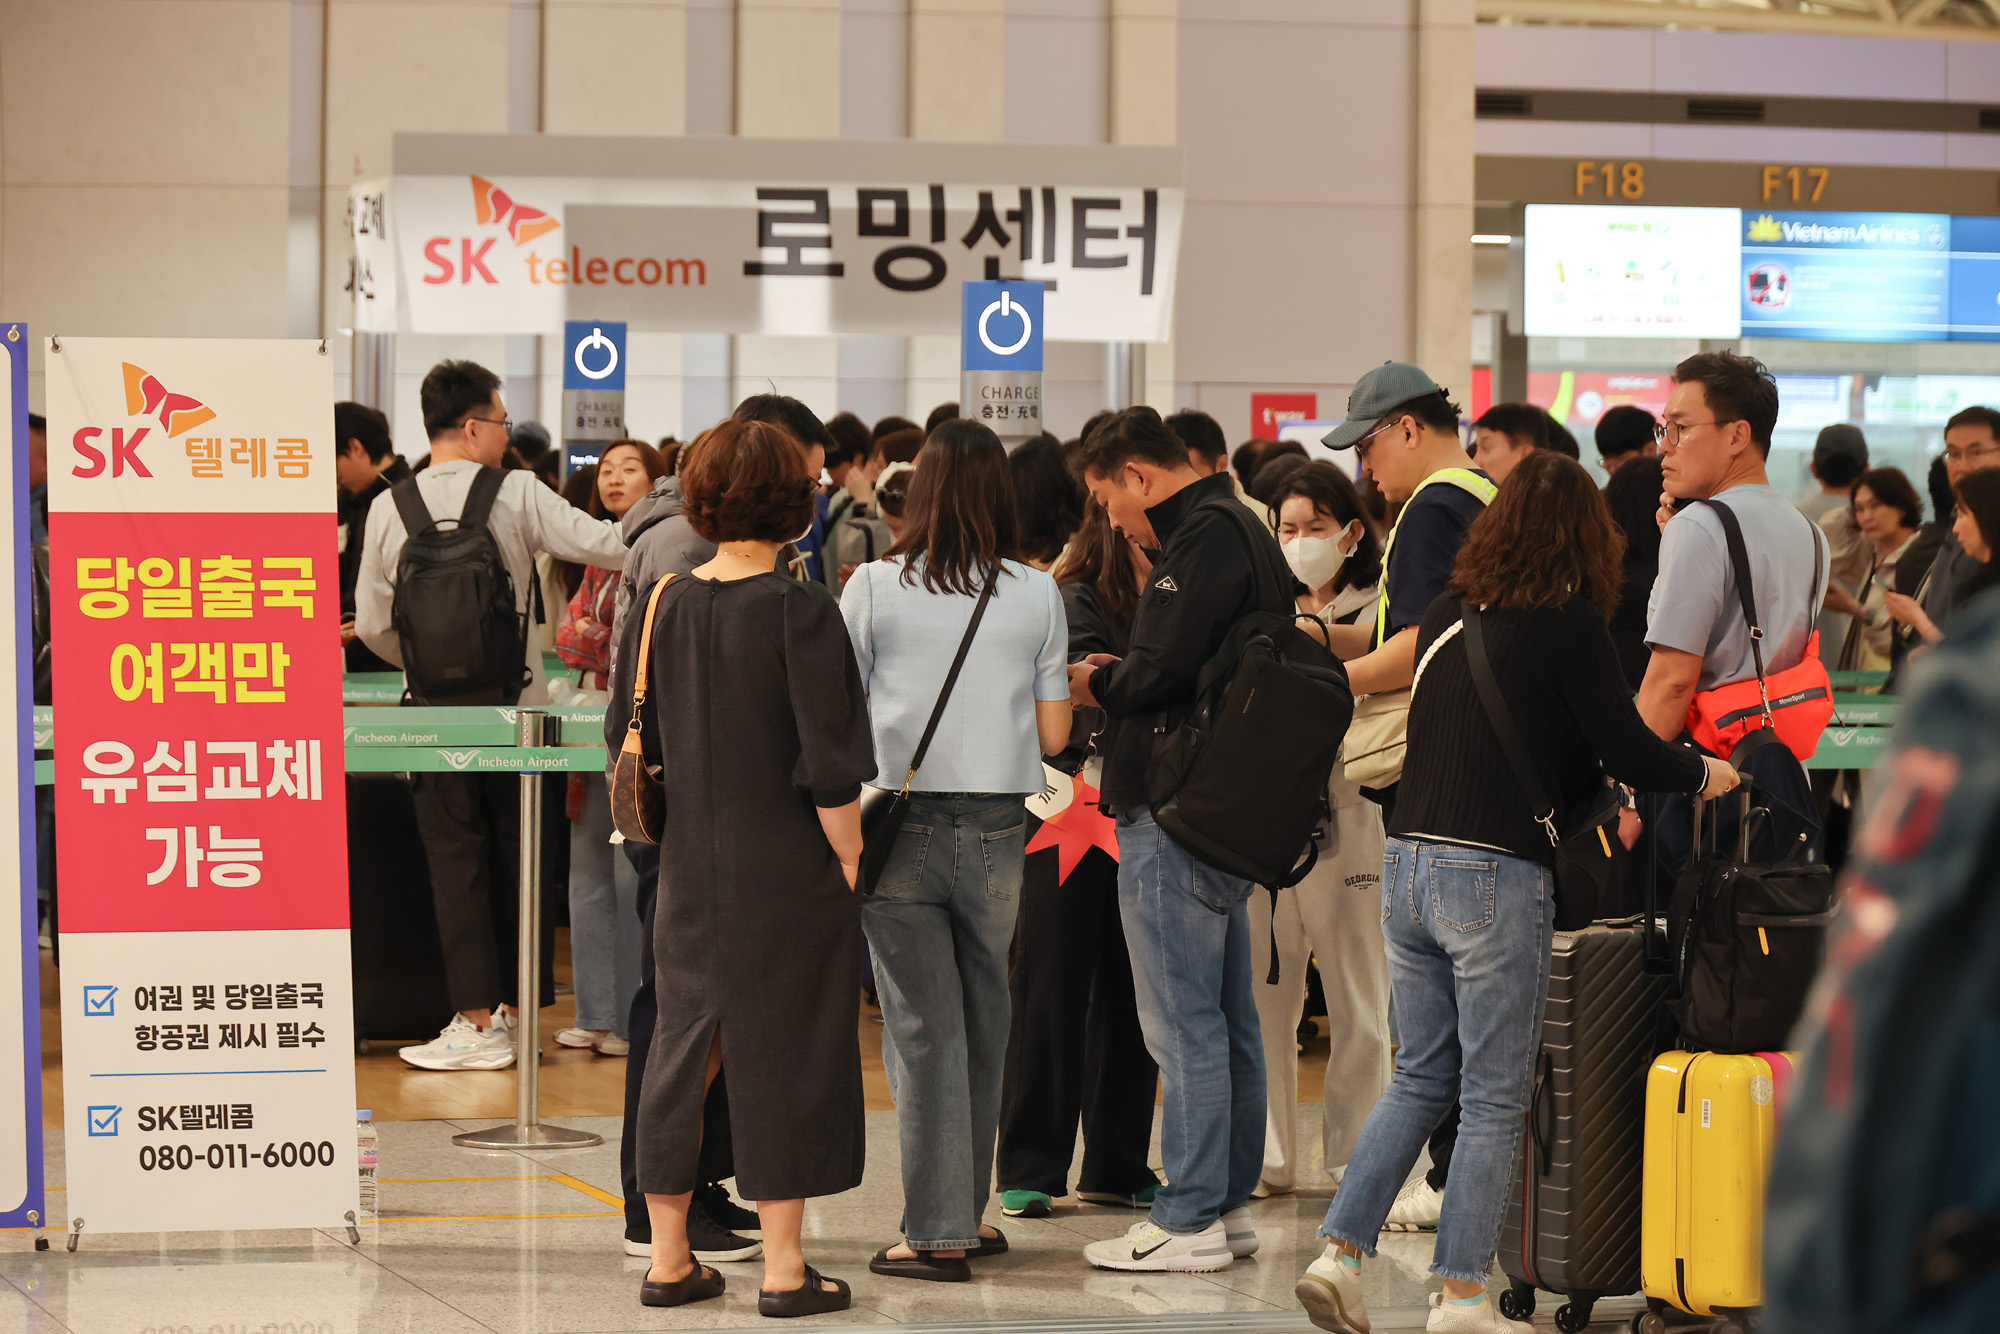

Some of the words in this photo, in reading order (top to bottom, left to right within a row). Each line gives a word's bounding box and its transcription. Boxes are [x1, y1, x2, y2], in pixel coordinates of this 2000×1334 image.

[1575, 161, 1646, 199] F18
[1762, 166, 1830, 203] F17
[743, 183, 1159, 296] 로밍센터
[1782, 221, 1856, 244] Vietnam
[1856, 224, 1921, 246] Airlines
[422, 236, 499, 285] SK
[525, 244, 707, 286] telecom
[981, 386, 1039, 399] CHARGE
[71, 426, 154, 479] SK
[185, 437, 313, 479] 텔레콤
[76, 554, 317, 619] 당일출국
[109, 641, 291, 704] 여객만
[571, 712, 605, 723] Airport
[354, 733, 397, 743] Incheon
[400, 733, 438, 743] Airport
[80, 739, 323, 804] 유심교체
[478, 757, 524, 768] Incheon
[527, 756, 569, 768] Airport
[145, 825, 264, 888] 가능
[1344, 873, 1380, 887] GEORGIA
[134, 985, 184, 1012] 여권
[192, 984, 216, 1011] 및
[224, 982, 325, 1010] 당일출국
[134, 1023, 209, 1051] 항공권
[218, 1023, 268, 1050] 제시
[276, 1021, 327, 1049] 필수
[137, 1103, 255, 1133] SK텔레콤
[138, 1140, 336, 1172] 080-011-6000
